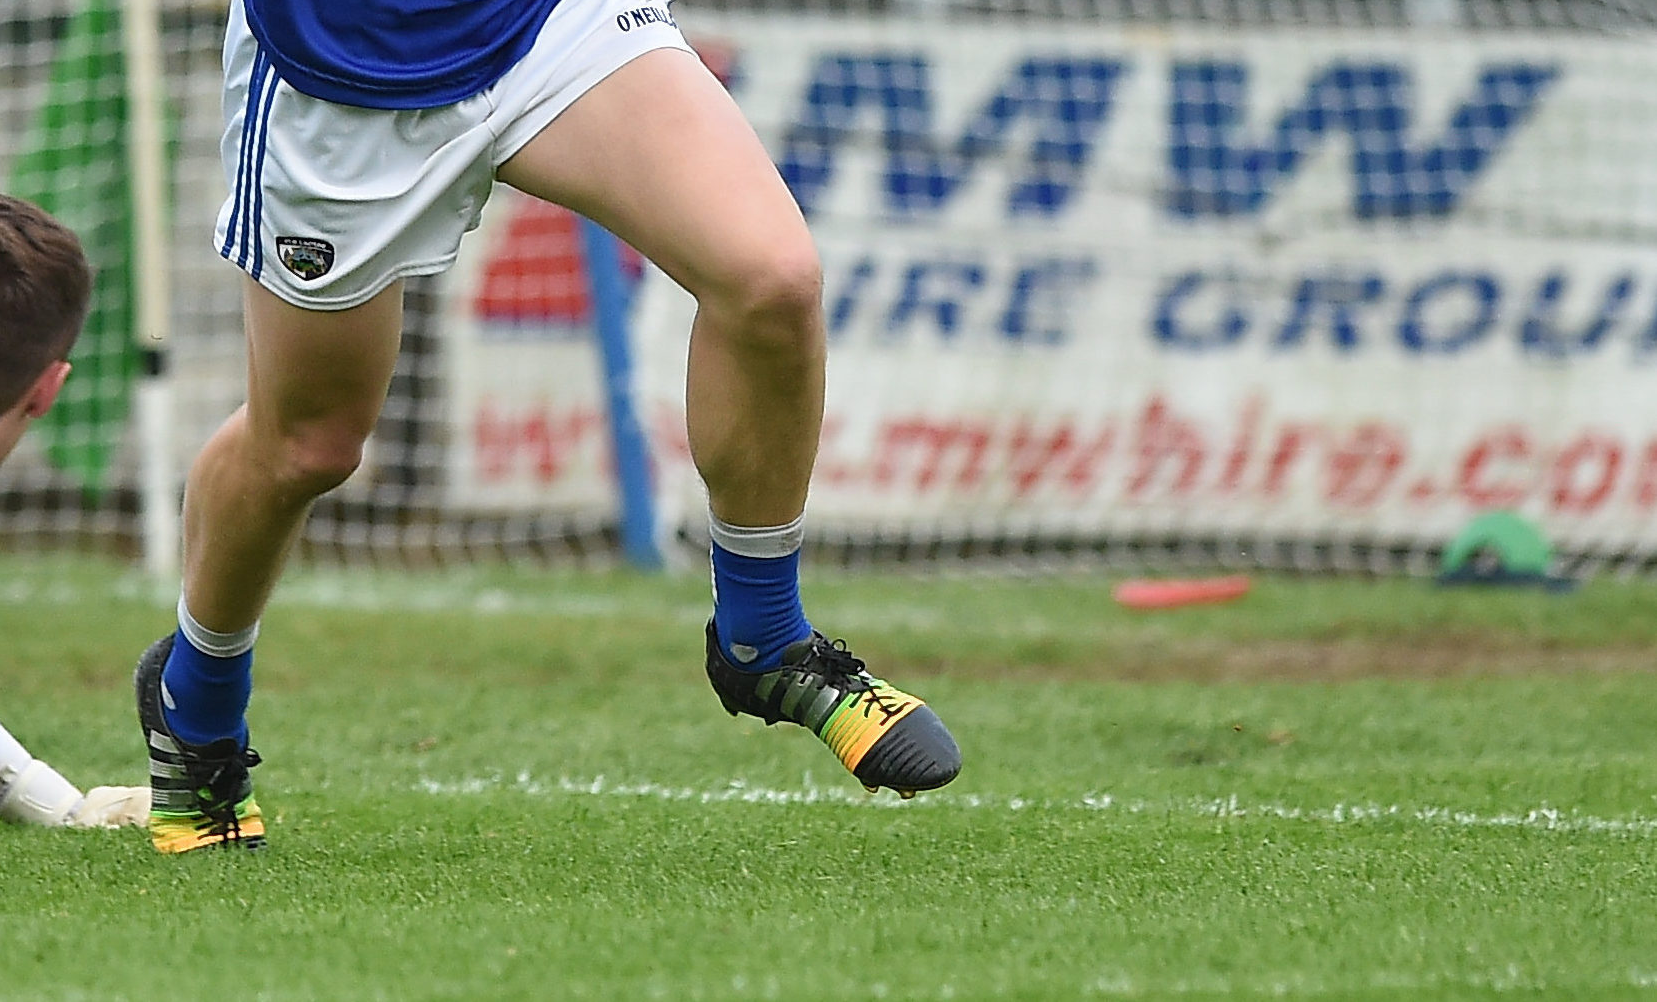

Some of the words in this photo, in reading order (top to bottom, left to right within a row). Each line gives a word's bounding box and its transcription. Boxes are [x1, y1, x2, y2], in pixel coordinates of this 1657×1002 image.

[779, 54, 1565, 224] MW
[827, 255, 1101, 350] IRE
[1151, 266, 1657, 362] GROU
